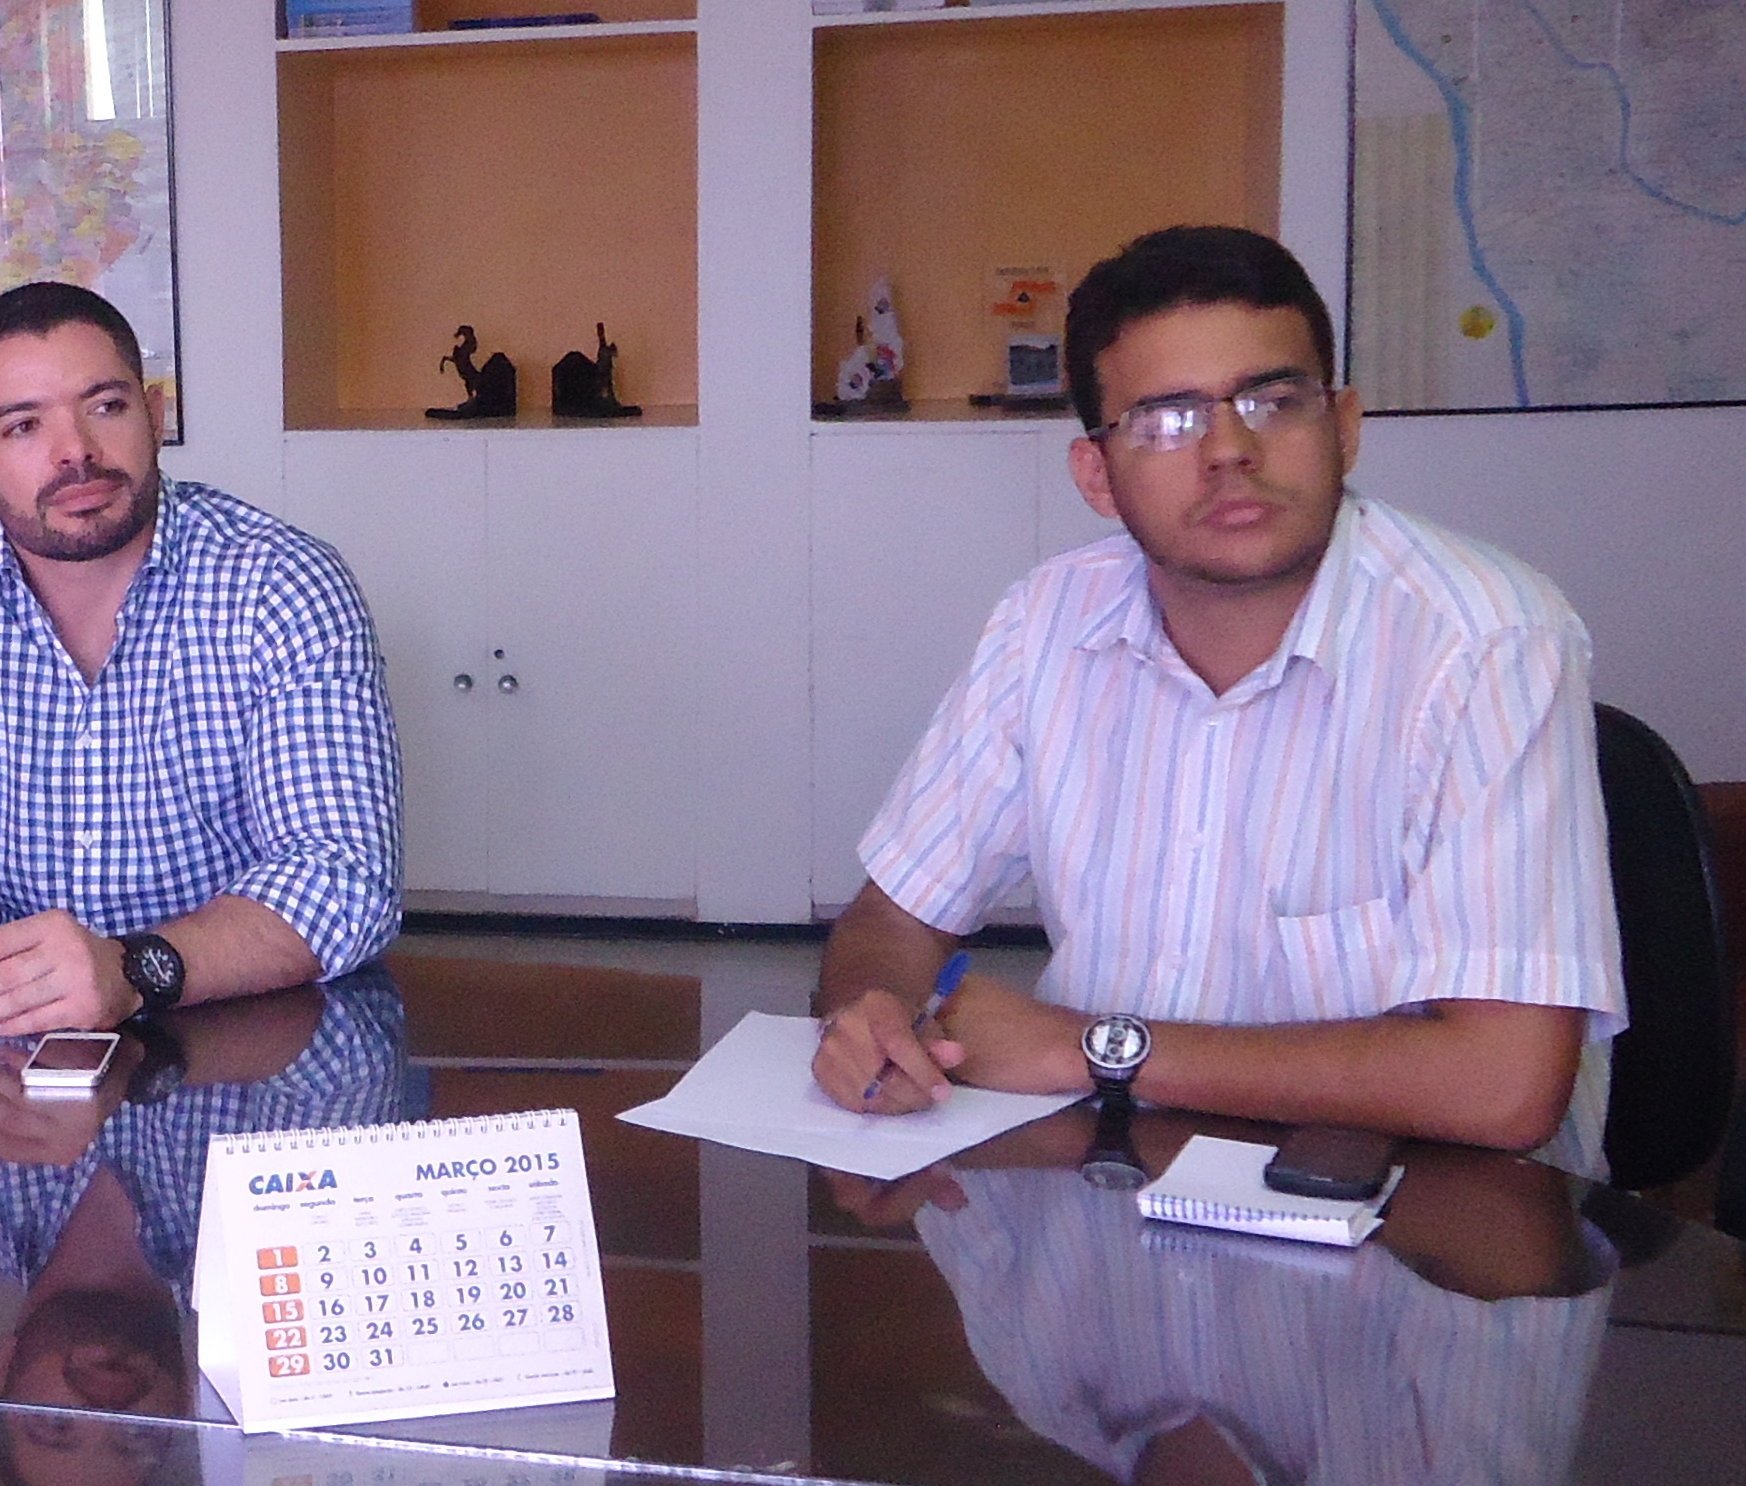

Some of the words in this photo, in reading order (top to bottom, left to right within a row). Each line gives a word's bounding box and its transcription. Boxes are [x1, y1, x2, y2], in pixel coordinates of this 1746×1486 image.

[248, 1169, 338, 1195] CAIXA
[416, 1157, 497, 1181] MARÇO
[504, 1152, 560, 1174] 2015
[275, 1248, 282, 1267] 1
[317, 1245, 331, 1263] 2
[364, 1241, 377, 1259] 3
[409, 1237, 423, 1254] 4
[455, 1233, 468, 1251] 5
[499, 1230, 513, 1247] 6
[543, 1224, 556, 1243] 7
[274, 1275, 287, 1294] 8
[320, 1272, 334, 1289] 9
[361, 1267, 388, 1286] 10
[407, 1263, 430, 1282] 11
[453, 1259, 479, 1278] 12
[497, 1254, 523, 1273] 13
[542, 1251, 568, 1270] 14
[272, 1301, 300, 1320] 15
[318, 1298, 345, 1317] 16
[364, 1294, 389, 1313] 17
[410, 1289, 436, 1309] 18
[456, 1285, 481, 1305] 19
[499, 1281, 527, 1300] 20
[544, 1277, 568, 1297] 21
[274, 1328, 302, 1347] 22
[319, 1325, 347, 1344] 23
[366, 1321, 394, 1340] 24
[412, 1317, 439, 1336] 25
[457, 1313, 485, 1332] 26
[502, 1308, 528, 1327] 27
[547, 1304, 575, 1323] 28
[277, 1355, 305, 1374] 29
[323, 1351, 351, 1371] 30
[369, 1348, 393, 1367] 31
